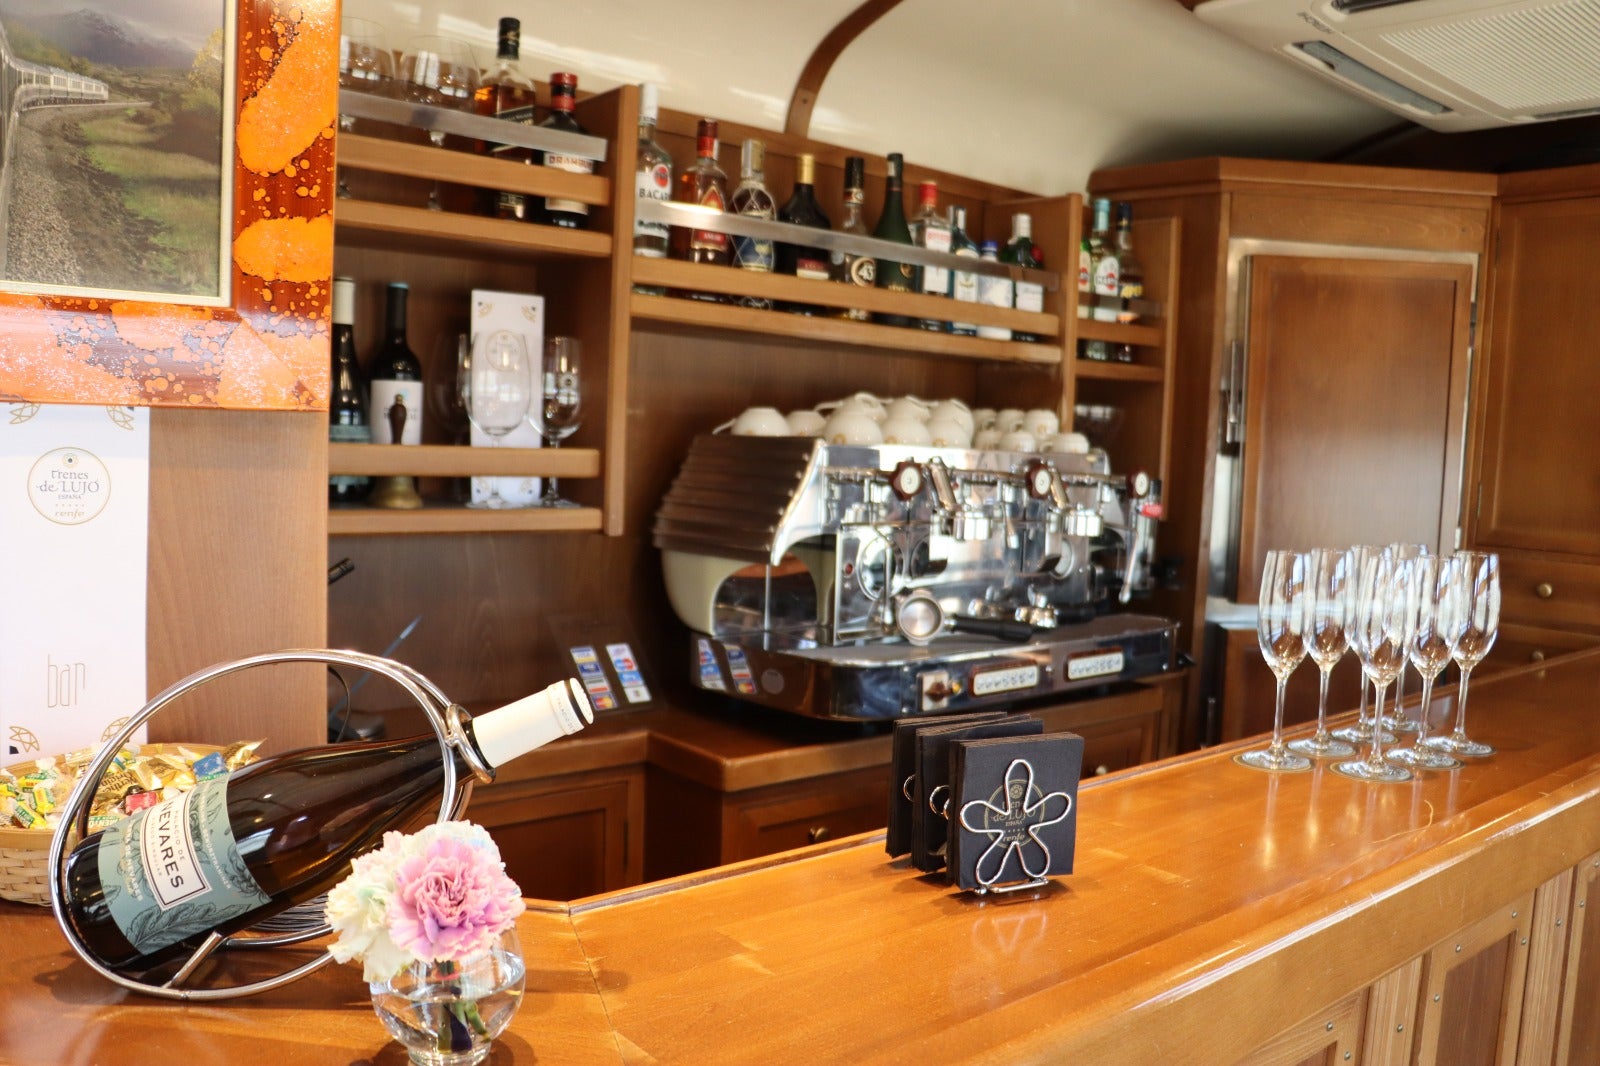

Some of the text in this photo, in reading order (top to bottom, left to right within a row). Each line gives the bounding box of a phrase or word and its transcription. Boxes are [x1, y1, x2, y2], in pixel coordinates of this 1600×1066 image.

[51, 469, 89, 480] trenes
[36, 480, 58, 493] de
[55, 509, 85, 519] renfe
[47, 653, 86, 708] bar
[1003, 832, 1025, 842] renfe
[158, 801, 184, 888] NEVARES
